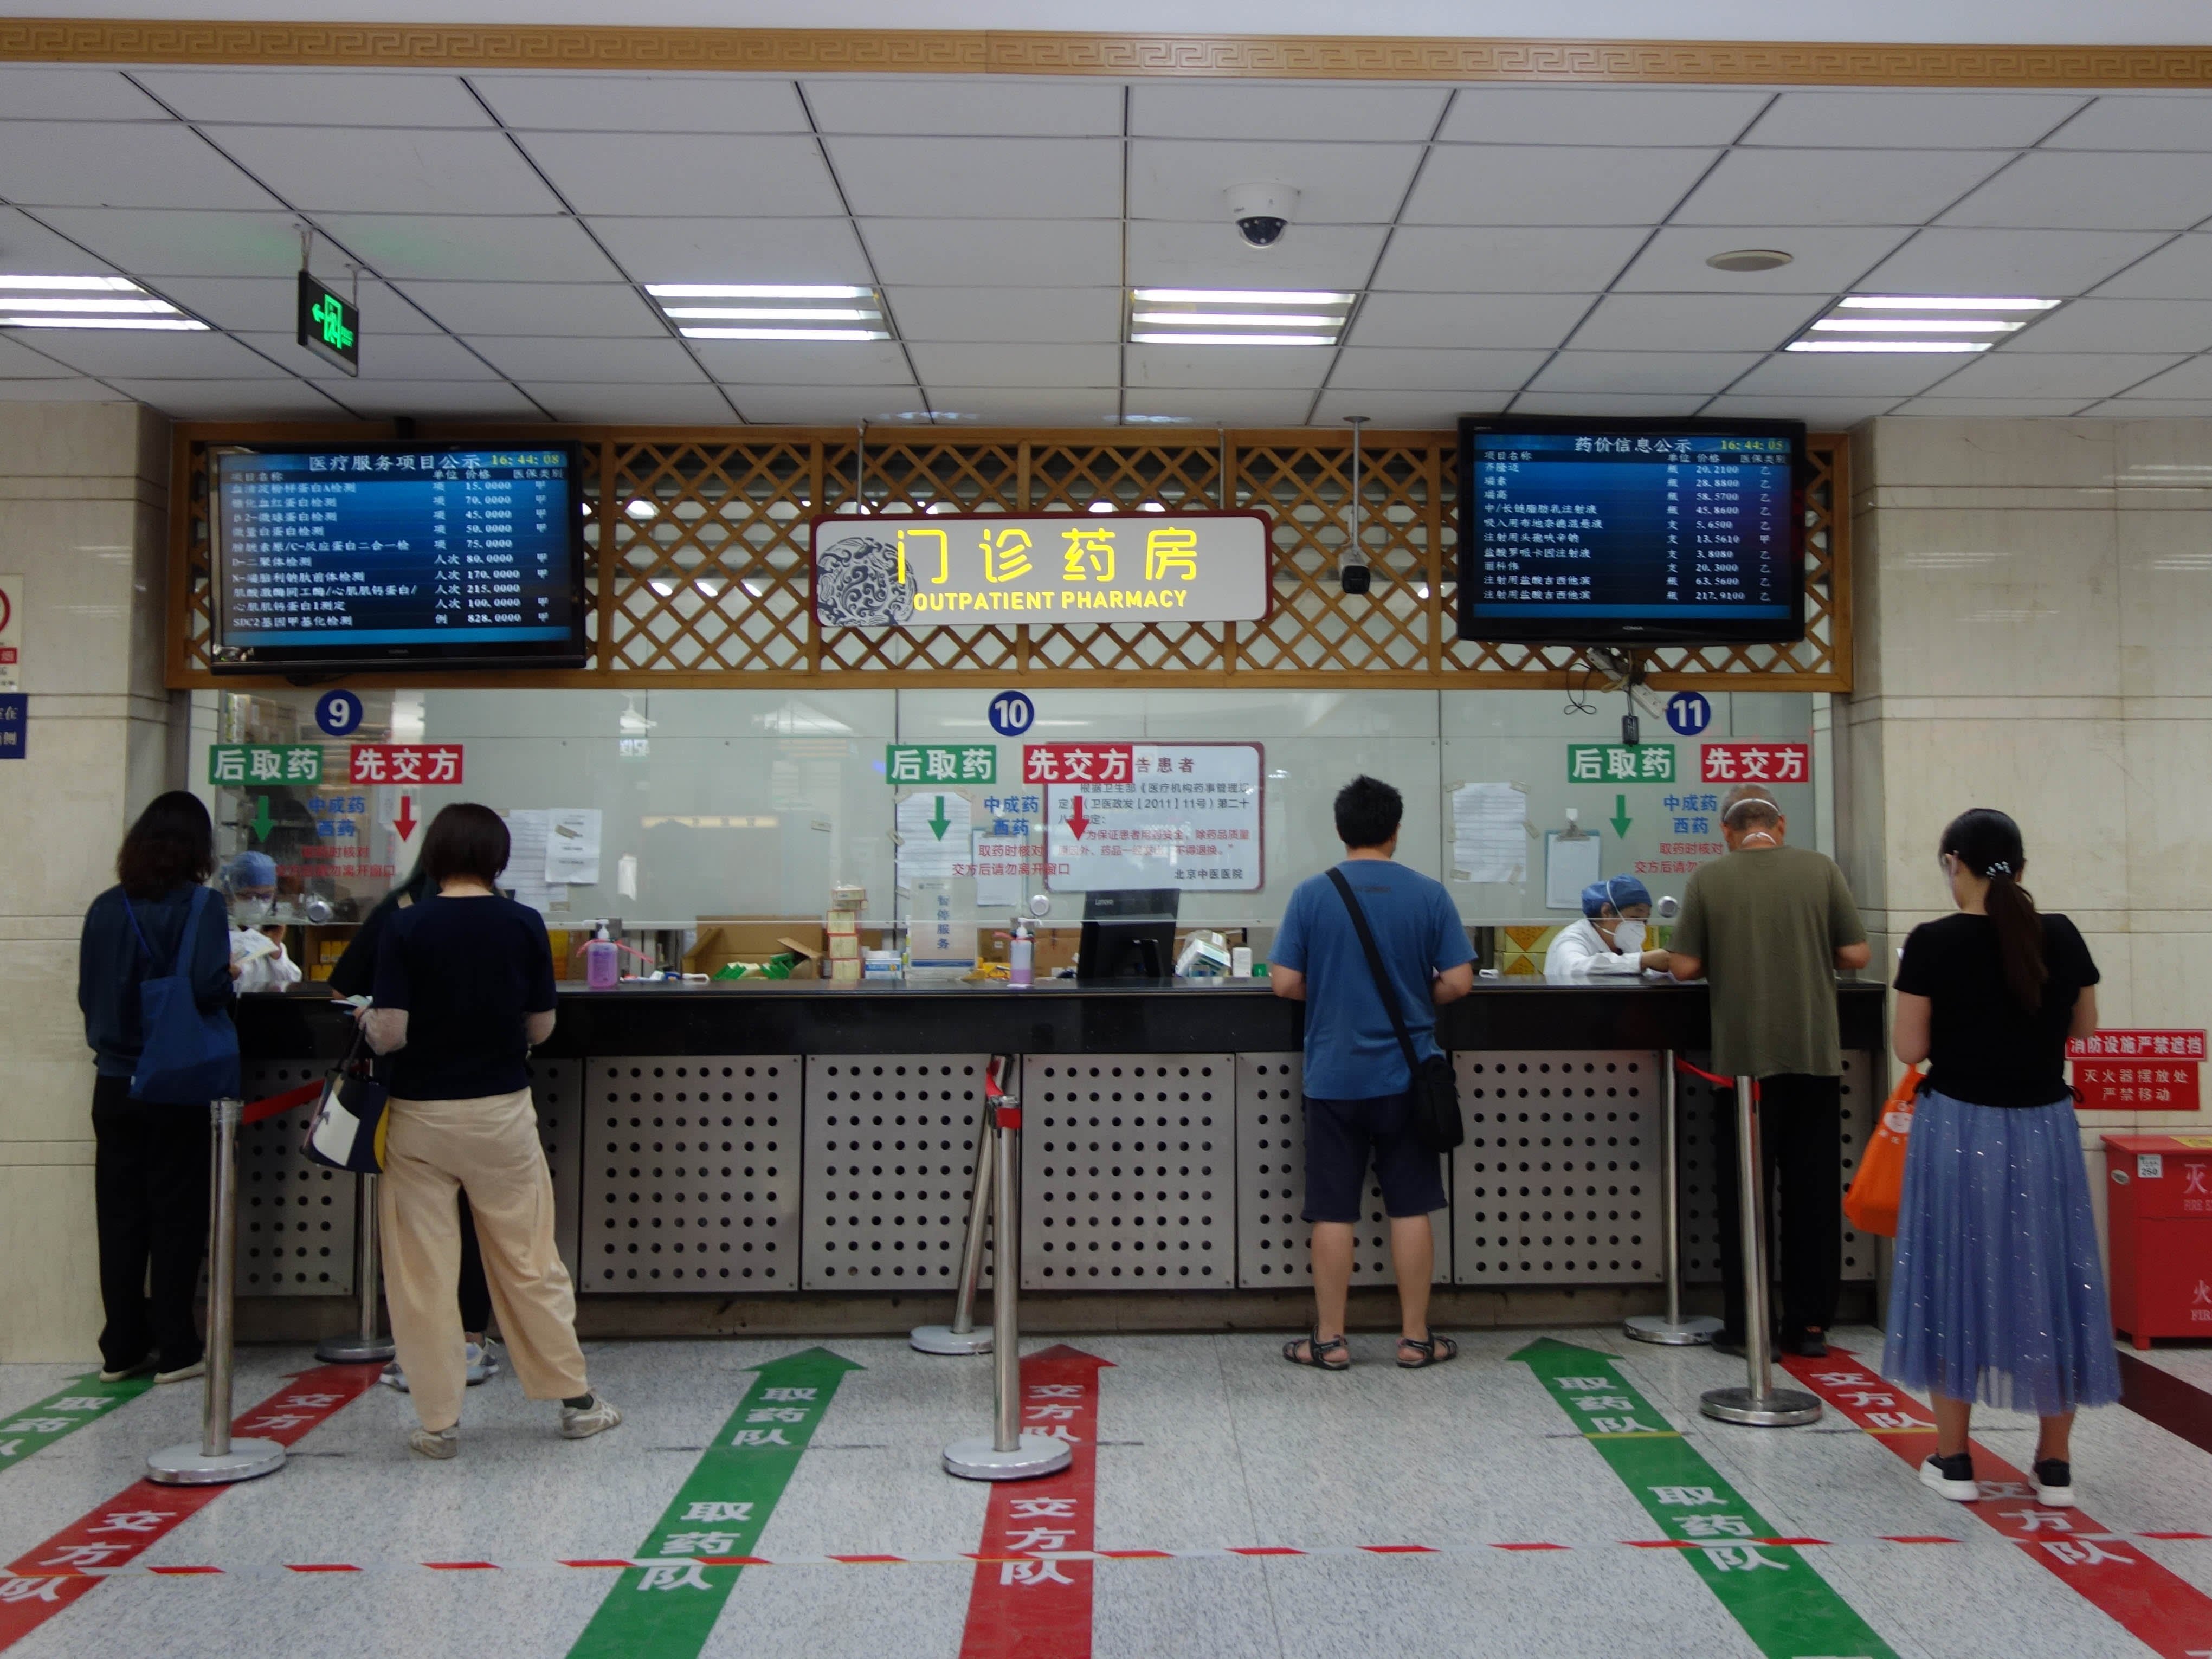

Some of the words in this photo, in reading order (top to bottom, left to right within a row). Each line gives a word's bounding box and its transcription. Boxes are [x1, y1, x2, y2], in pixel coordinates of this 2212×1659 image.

[1575, 437, 1692, 453] 药价信息公示
[309, 455, 481, 471] 医疗服务项目公示
[1484, 451, 1533, 461] 项目名称
[1667, 454, 1691, 463] 单位
[1697, 454, 1721, 463] 价格
[1740, 454, 1787, 464] 医保类别
[231, 472, 283, 481] 项目名称
[433, 469, 459, 479] 单位
[466, 469, 491, 479] 价格
[513, 469, 564, 479] 医保类别
[1667, 464, 1679, 474] 瓶
[1760, 466, 1771, 475] 乙
[433, 482, 445, 491] 项
[535, 481, 546, 490] 甲
[1667, 478, 1679, 487] 瓶
[1760, 480, 1771, 488] 乙
[231, 498, 337, 508] 糖化血红蛋白检测
[433, 495, 446, 506] 项
[535, 495, 547, 504] 甲
[1484, 489, 1508, 500] 瑞高
[1667, 491, 1679, 501] 瓶
[1760, 493, 1771, 502] 乙
[434, 510, 446, 520] 项
[536, 509, 547, 518] 甲
[1484, 503, 1598, 514] 中/长链脂肪乳注射液
[1666, 505, 1680, 515] 瓶
[1760, 507, 1772, 516] 乙
[232, 526, 325, 537] 微量白蛋白检测
[434, 524, 446, 534] 项
[536, 523, 547, 533] 甲
[1484, 518, 1604, 529] 吸入用布地奈德混悬液
[1666, 520, 1679, 531] 支
[1760, 521, 1771, 531] 乙
[434, 539, 447, 550] 项
[1484, 533, 1579, 543] 注射用头孢呋辛钠
[1666, 534, 1679, 544] 支
[1759, 535, 1771, 544] 甲
[434, 554, 460, 565] 人次
[537, 553, 548, 563] 甲
[896, 527, 1198, 585] 门诊药房
[1484, 547, 1591, 559] 盐酸罗哌卡因注射液
[1666, 549, 1679, 559] 支
[1760, 550, 1771, 560] 乙
[435, 570, 461, 580] 人次
[537, 569, 549, 579] 甲
[1666, 563, 1679, 573] 支
[1760, 564, 1772, 573] 乙
[1484, 575, 1591, 586] 注射用盐酸吉西他滨
[1666, 576, 1679, 586] 瓶
[1760, 577, 1772, 587] 乙
[435, 584, 461, 595] 人次
[1484, 590, 1591, 601] 注射用盐酸吉西他滨
[1666, 590, 1679, 601] 瓶
[1760, 592, 1772, 601] 乙
[435, 598, 461, 609] 人次
[538, 597, 549, 608] 甲
[913, 591, 1056, 611] OUTPATIENT
[1061, 589, 1188, 610] PHARMACY
[435, 614, 448, 625] 例
[538, 612, 549, 623] 甲
[327, 698, 350, 727] 9
[994, 699, 1028, 728] 10
[1672, 699, 1703, 727] 11
[214, 748, 318, 781] 后取药
[354, 748, 460, 781] 先交方
[891, 748, 991, 780] 后取药
[1027, 748, 1129, 781] 先交方
[1572, 748, 1672, 779] 后取药
[1705, 747, 1805, 779] 先交方
[307, 796, 366, 813] 中成药
[983, 796, 1039, 813] 中成药
[1662, 794, 1717, 811] 中成药
[317, 819, 356, 837] 西药
[992, 819, 1029, 836] 西药
[1672, 816, 1709, 834] 西药
[978, 844, 1043, 857] 取药时核对
[1659, 843, 1724, 855] 取药时核对
[952, 863, 1069, 875] 交方后请勿离开窗口
[1175, 869, 1244, 880] 北京中医医院
[1634, 861, 1702, 873] 交方后请勿
[936, 895, 950, 950] 暂停服务
[2071, 1036, 2203, 1054] 消防设施严禁遮挡
[2084, 1069, 2188, 1083] 灭火器摆放处
[2103, 1087, 2170, 1102] 严禁移动
[2184, 1163, 2212, 1193] 灭
[1553, 1377, 1660, 1434] 取药队
[1809, 1372, 1937, 1429] 交方队
[731, 1387, 818, 1445] 取药队
[1647, 1486, 1791, 1572] 取药队
[636, 1501, 754, 1591] 取药队
[998, 1497, 1077, 1586] 交方队
